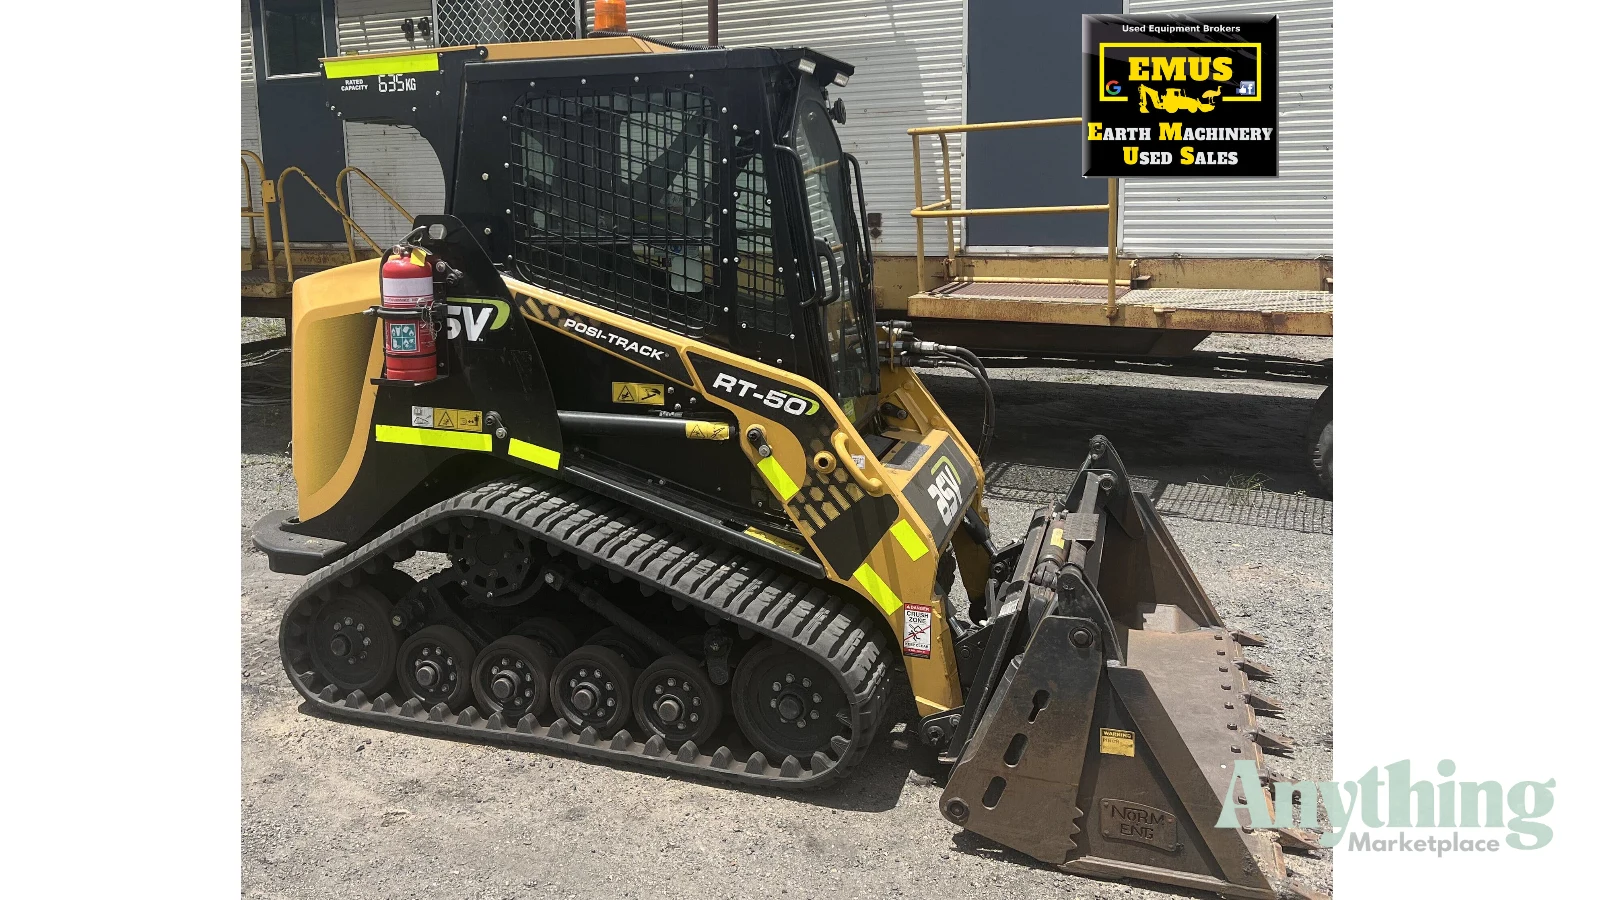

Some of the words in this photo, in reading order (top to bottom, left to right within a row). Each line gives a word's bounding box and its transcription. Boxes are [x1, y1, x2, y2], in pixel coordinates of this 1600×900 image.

[447, 305, 494, 342] SV
[712, 372, 807, 416] RT-50
[1103, 730, 1132, 739] WARNING
[1120, 823, 1154, 840] ENG
